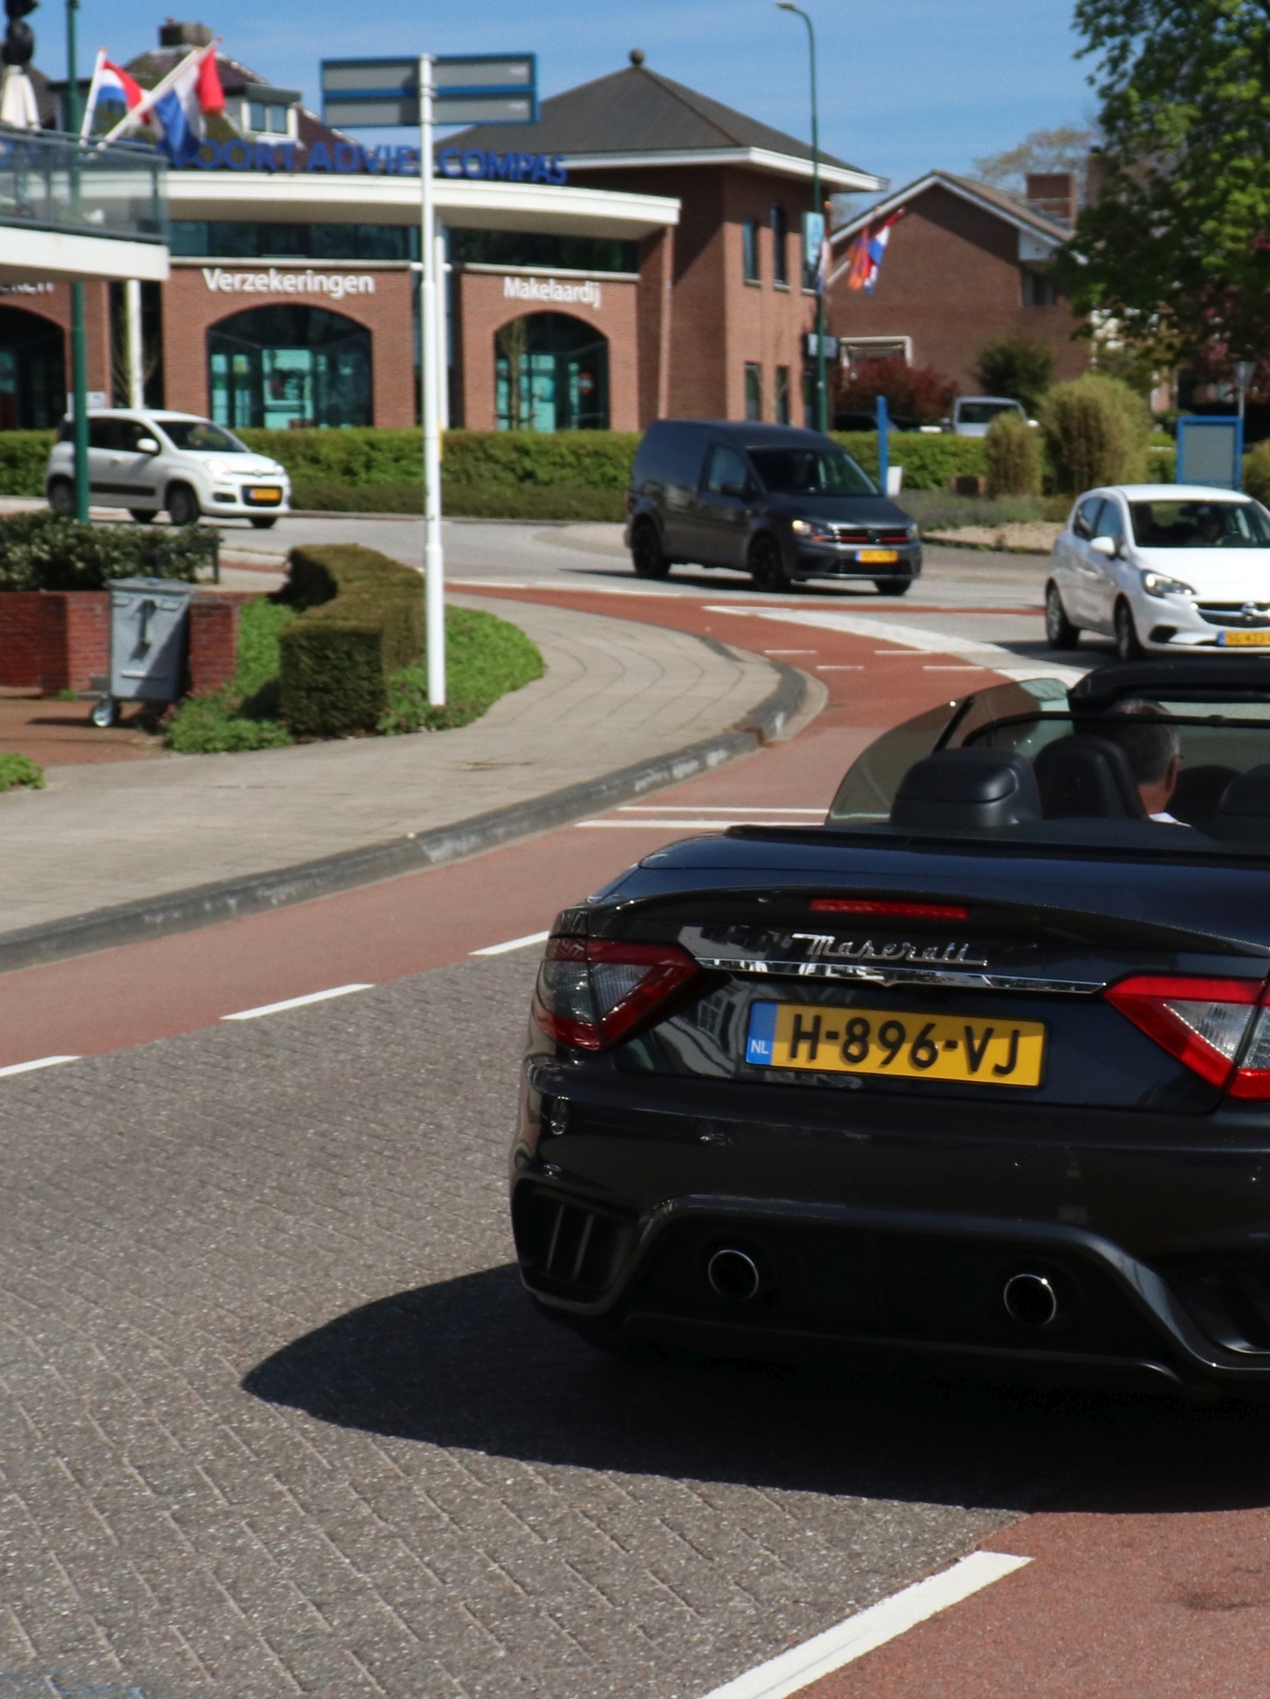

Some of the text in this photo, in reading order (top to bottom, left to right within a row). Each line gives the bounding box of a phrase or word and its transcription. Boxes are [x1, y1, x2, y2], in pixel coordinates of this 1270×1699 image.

[307, 141, 421, 175] ADVIE
[438, 146, 568, 184] COMPAS
[202, 268, 375, 299] Verzekeringen
[504, 277, 600, 308] Makelaardij
[792, 933, 988, 967] Maserati
[750, 1040, 769, 1055] NL
[789, 1013, 1021, 1076] H-896-VJ
